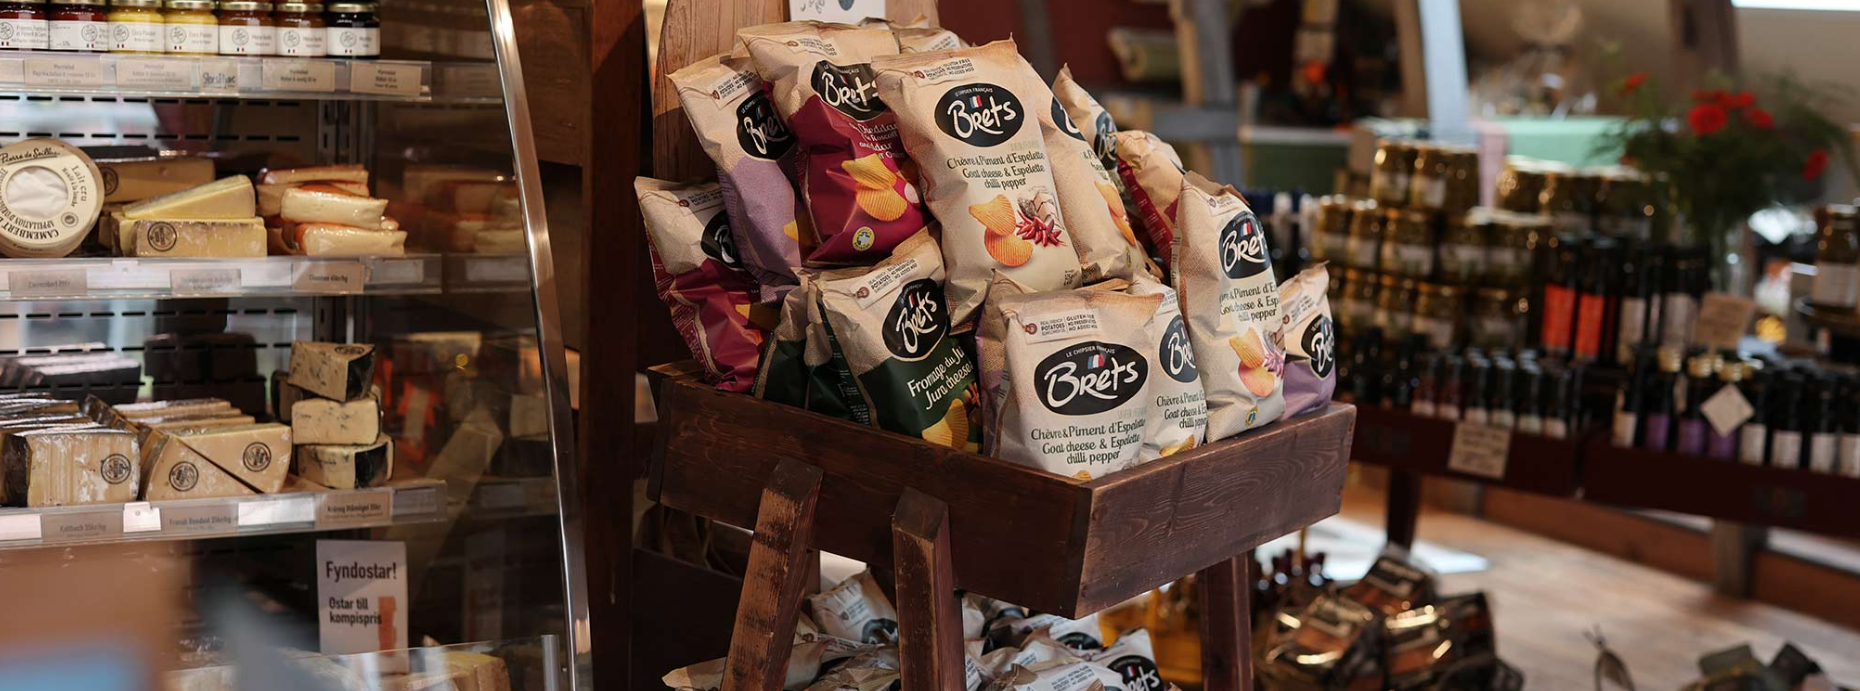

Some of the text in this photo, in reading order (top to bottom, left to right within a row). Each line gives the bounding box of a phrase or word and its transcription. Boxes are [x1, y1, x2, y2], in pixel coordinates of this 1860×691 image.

[948, 96, 1016, 138] Brets
[744, 116, 788, 154] Bret
[1006, 151, 1045, 164] d'Espelette
[72, 166, 86, 183] Lait
[962, 164, 1045, 178] Goat cheese & Espelette
[1000, 177, 1026, 190] pepper
[1, 222, 60, 240] CAMEMBERT
[1222, 224, 1269, 273] Bret
[1234, 286, 1262, 298] Piment
[1257, 298, 1264, 308] &
[896, 292, 937, 354] Brets
[1250, 308, 1277, 322] pepper
[1041, 322, 1065, 332] POTATOES
[1073, 346, 1096, 356] CHIPSIER
[906, 347, 965, 398] Fromage du Ju
[926, 363, 972, 410] Jura cheese
[1044, 356, 1139, 408] Brets
[1156, 396, 1180, 407] Chèvre
[1164, 408, 1180, 420] Goat
[1180, 406, 1197, 418] cheese
[1031, 428, 1062, 440] Chèvre
[1068, 424, 1106, 438] Piment
[1108, 418, 1146, 435] d'Espelette
[1179, 418, 1208, 430] chilli peppe
[1042, 434, 1140, 454] Goat cheese & Espelette
[1066, 450, 1120, 465] chilli pepper
[326, 561, 397, 582] Fyndostar!
[329, 596, 368, 610] Ostar till
[330, 611, 382, 628] kompispris
